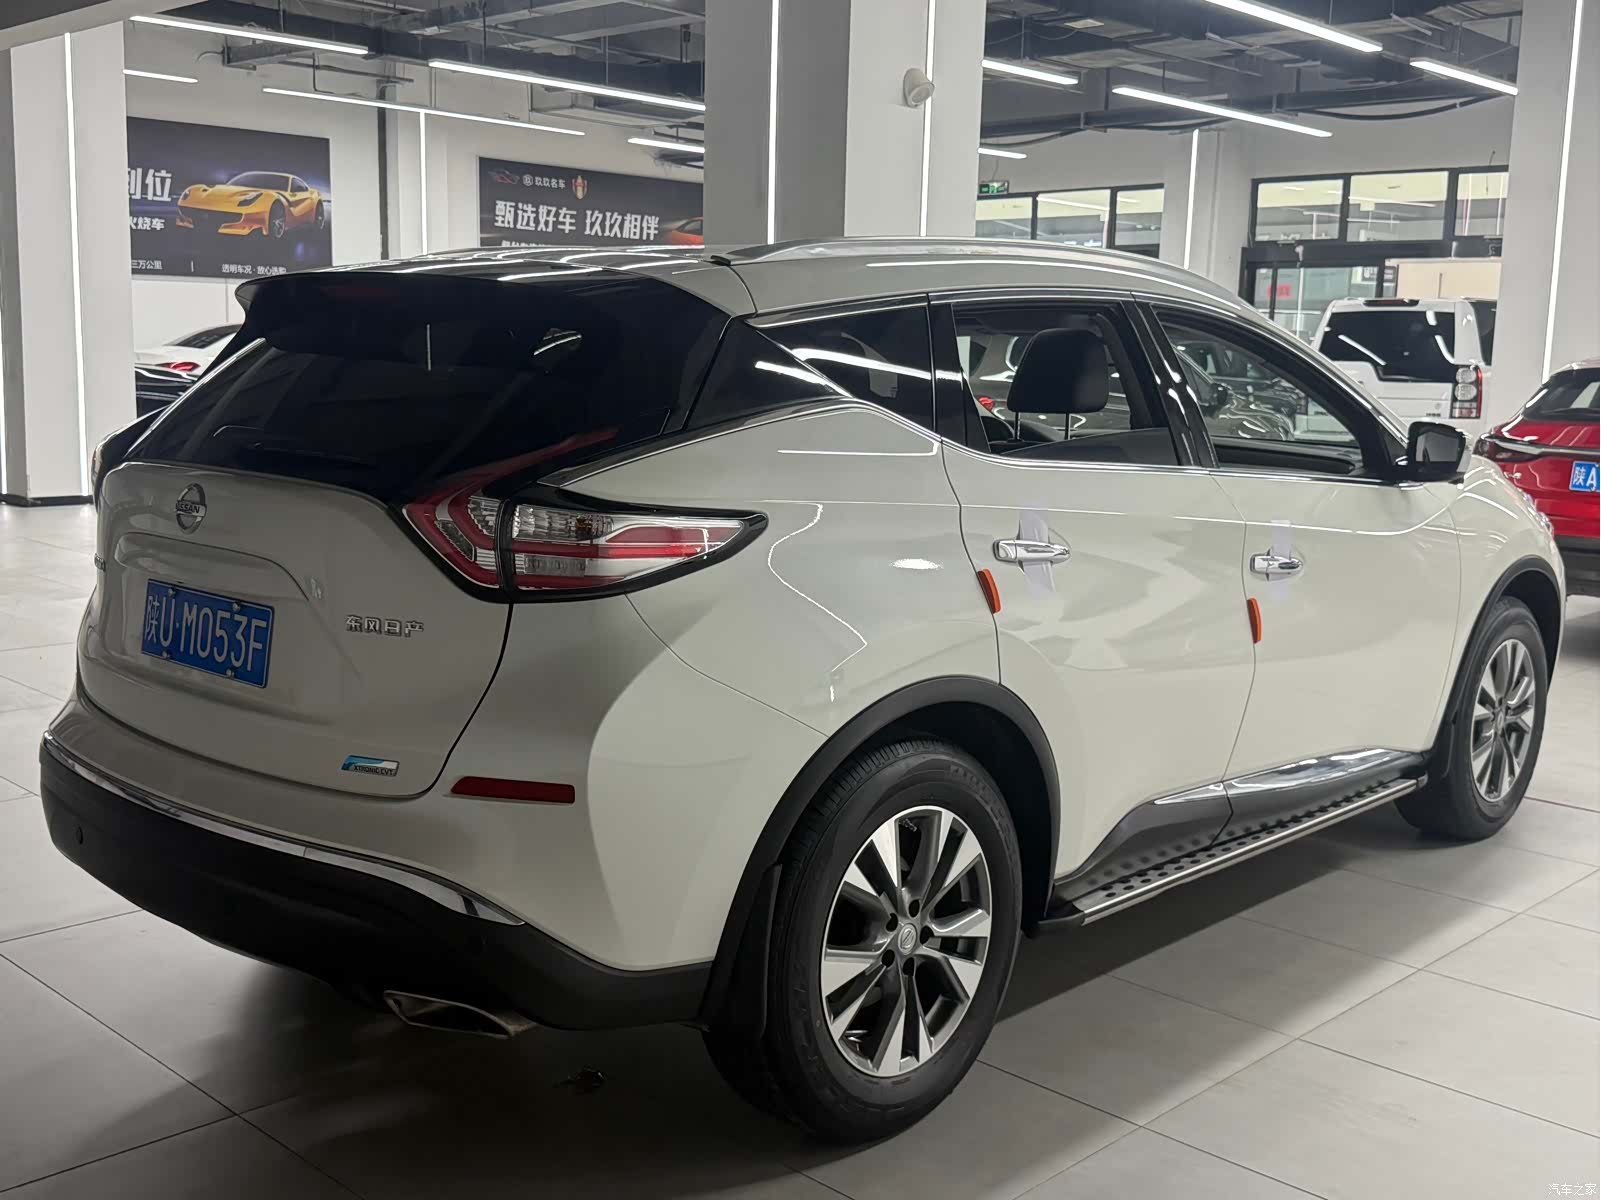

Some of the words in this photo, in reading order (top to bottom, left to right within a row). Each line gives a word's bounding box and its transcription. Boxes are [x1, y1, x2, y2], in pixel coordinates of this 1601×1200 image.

[535, 177, 566, 189] 玖玖名车
[494, 200, 577, 234] 甄选好车
[584, 210, 660, 241] 玖玖相伴
[345, 615, 424, 638] 东风日产
[380, 768, 394, 776] CVT
